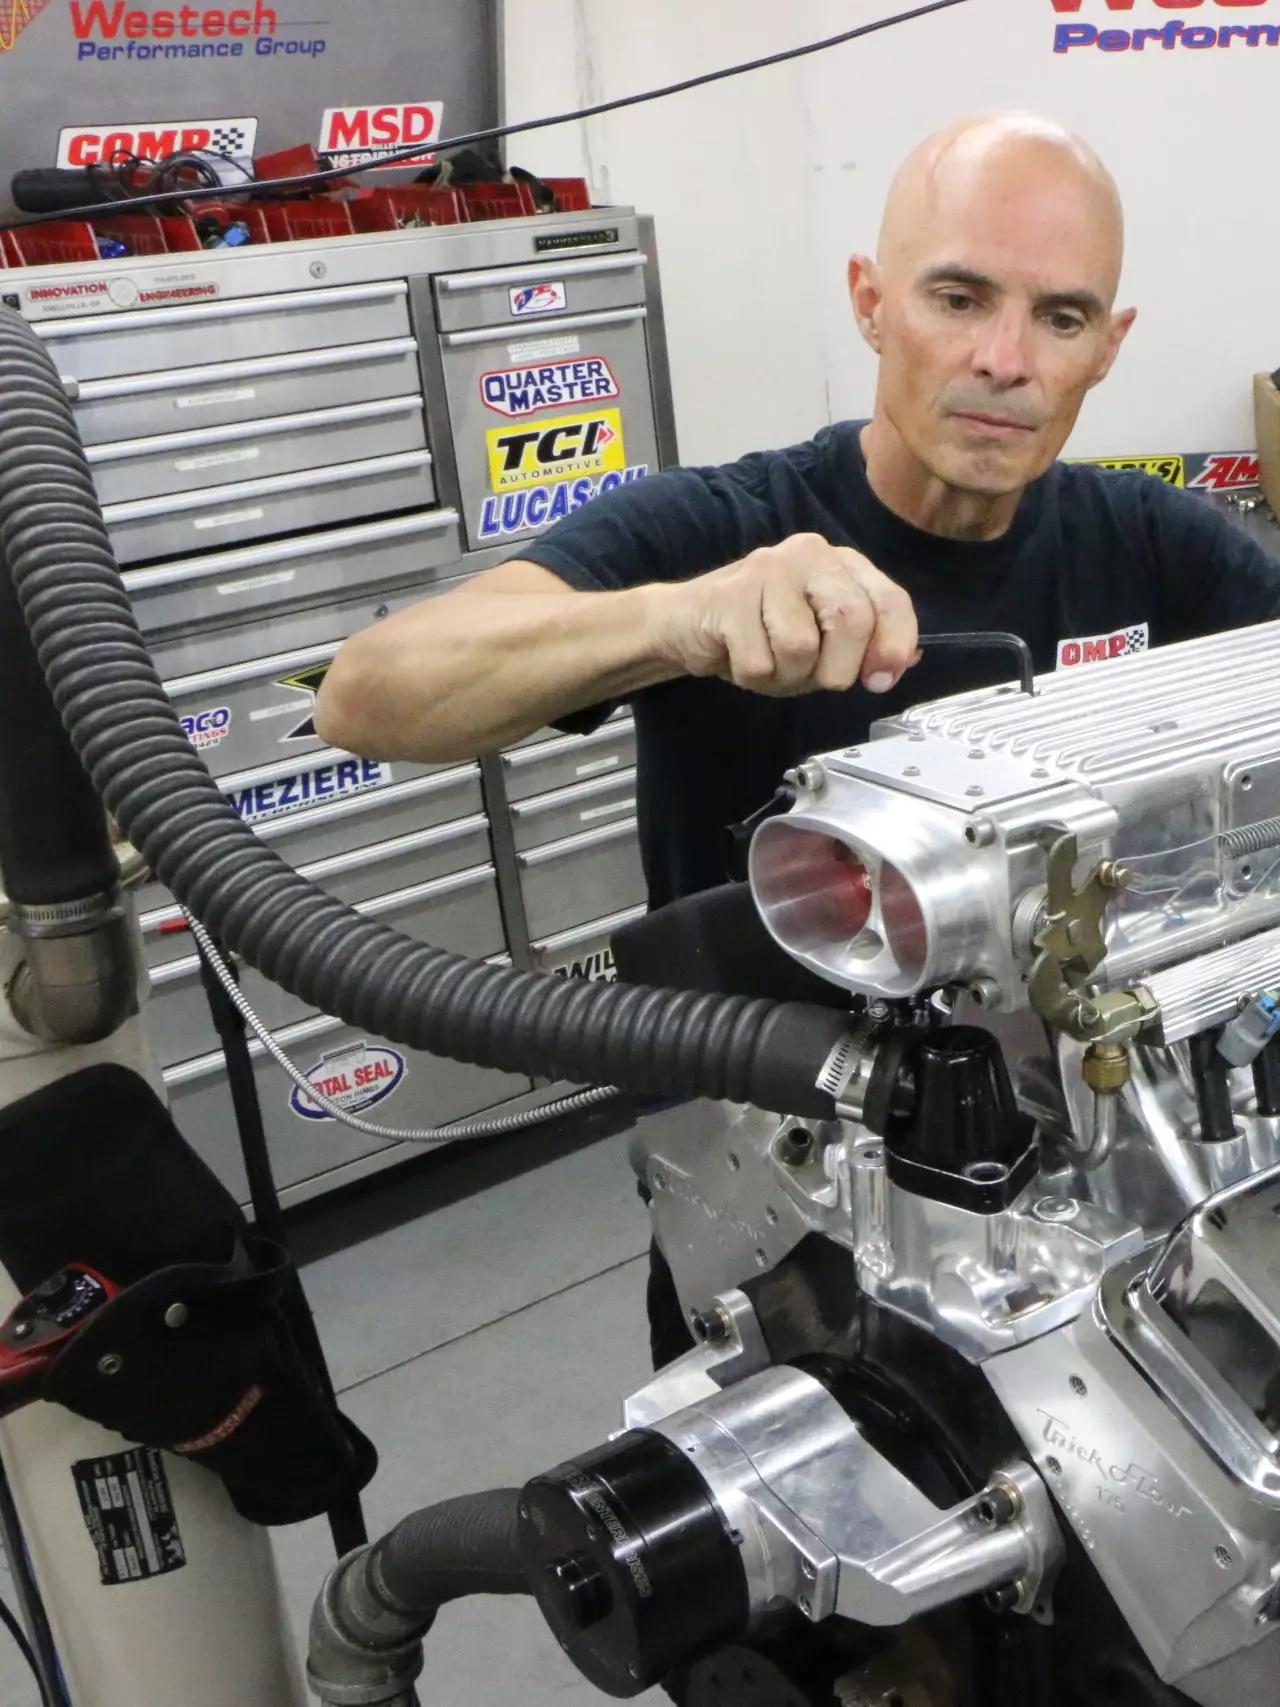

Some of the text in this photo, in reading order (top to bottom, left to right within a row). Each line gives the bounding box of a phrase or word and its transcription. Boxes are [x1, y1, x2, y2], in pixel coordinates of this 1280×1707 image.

[70, 0, 277, 39] Westech
[77, 37, 326, 61] Performance Group
[67, 128, 211, 166] COMP
[327, 106, 434, 149] MSD
[30, 282, 108, 299] INNOVATION
[484, 360, 604, 403] QUARTER
[509, 377, 612, 412] MASTER
[498, 420, 605, 472] TCI
[499, 458, 602, 486] AUTOMOTIVE
[480, 477, 594, 537] LUCAS
[1061, 634, 1127, 666] OMP
[226, 757, 382, 816] MEZIERE
[307, 1059, 395, 1103] OTAL SEAL
